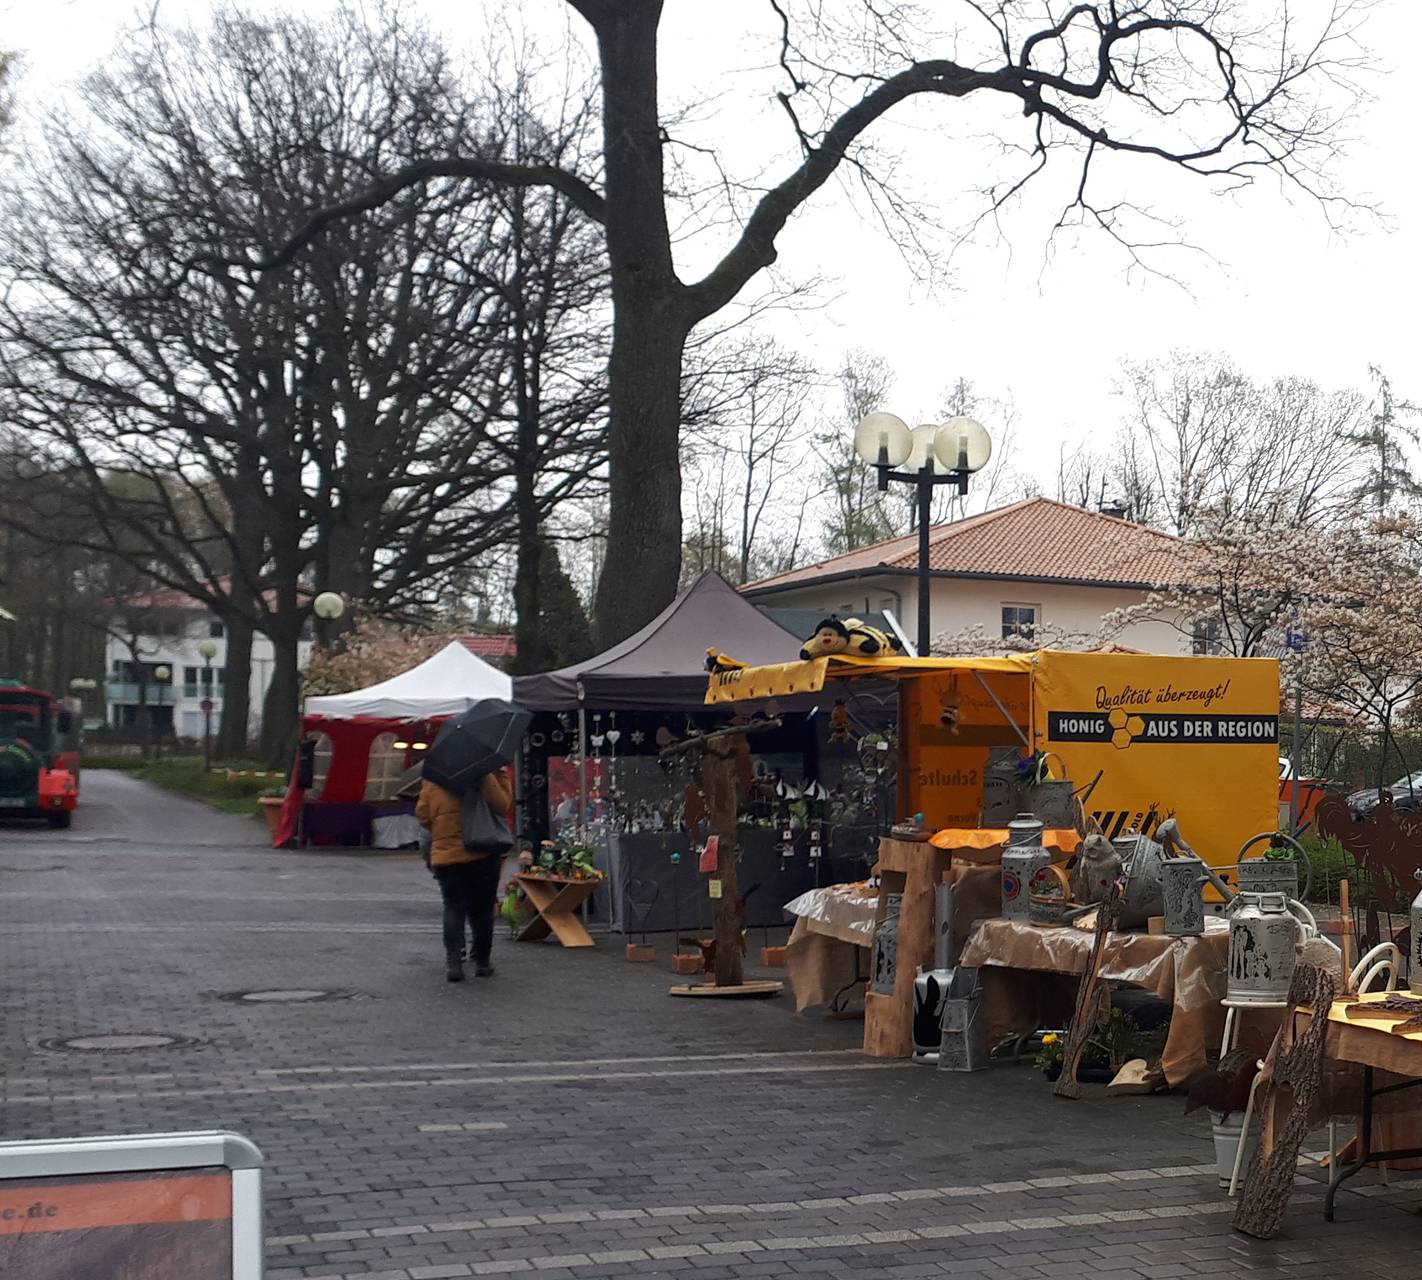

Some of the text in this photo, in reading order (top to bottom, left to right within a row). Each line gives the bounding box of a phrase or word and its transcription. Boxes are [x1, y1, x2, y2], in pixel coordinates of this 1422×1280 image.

[1096, 679, 1231, 709] Qualität überzeugt!
[1058, 718, 1275, 738] HONIG AUS DER REGION
